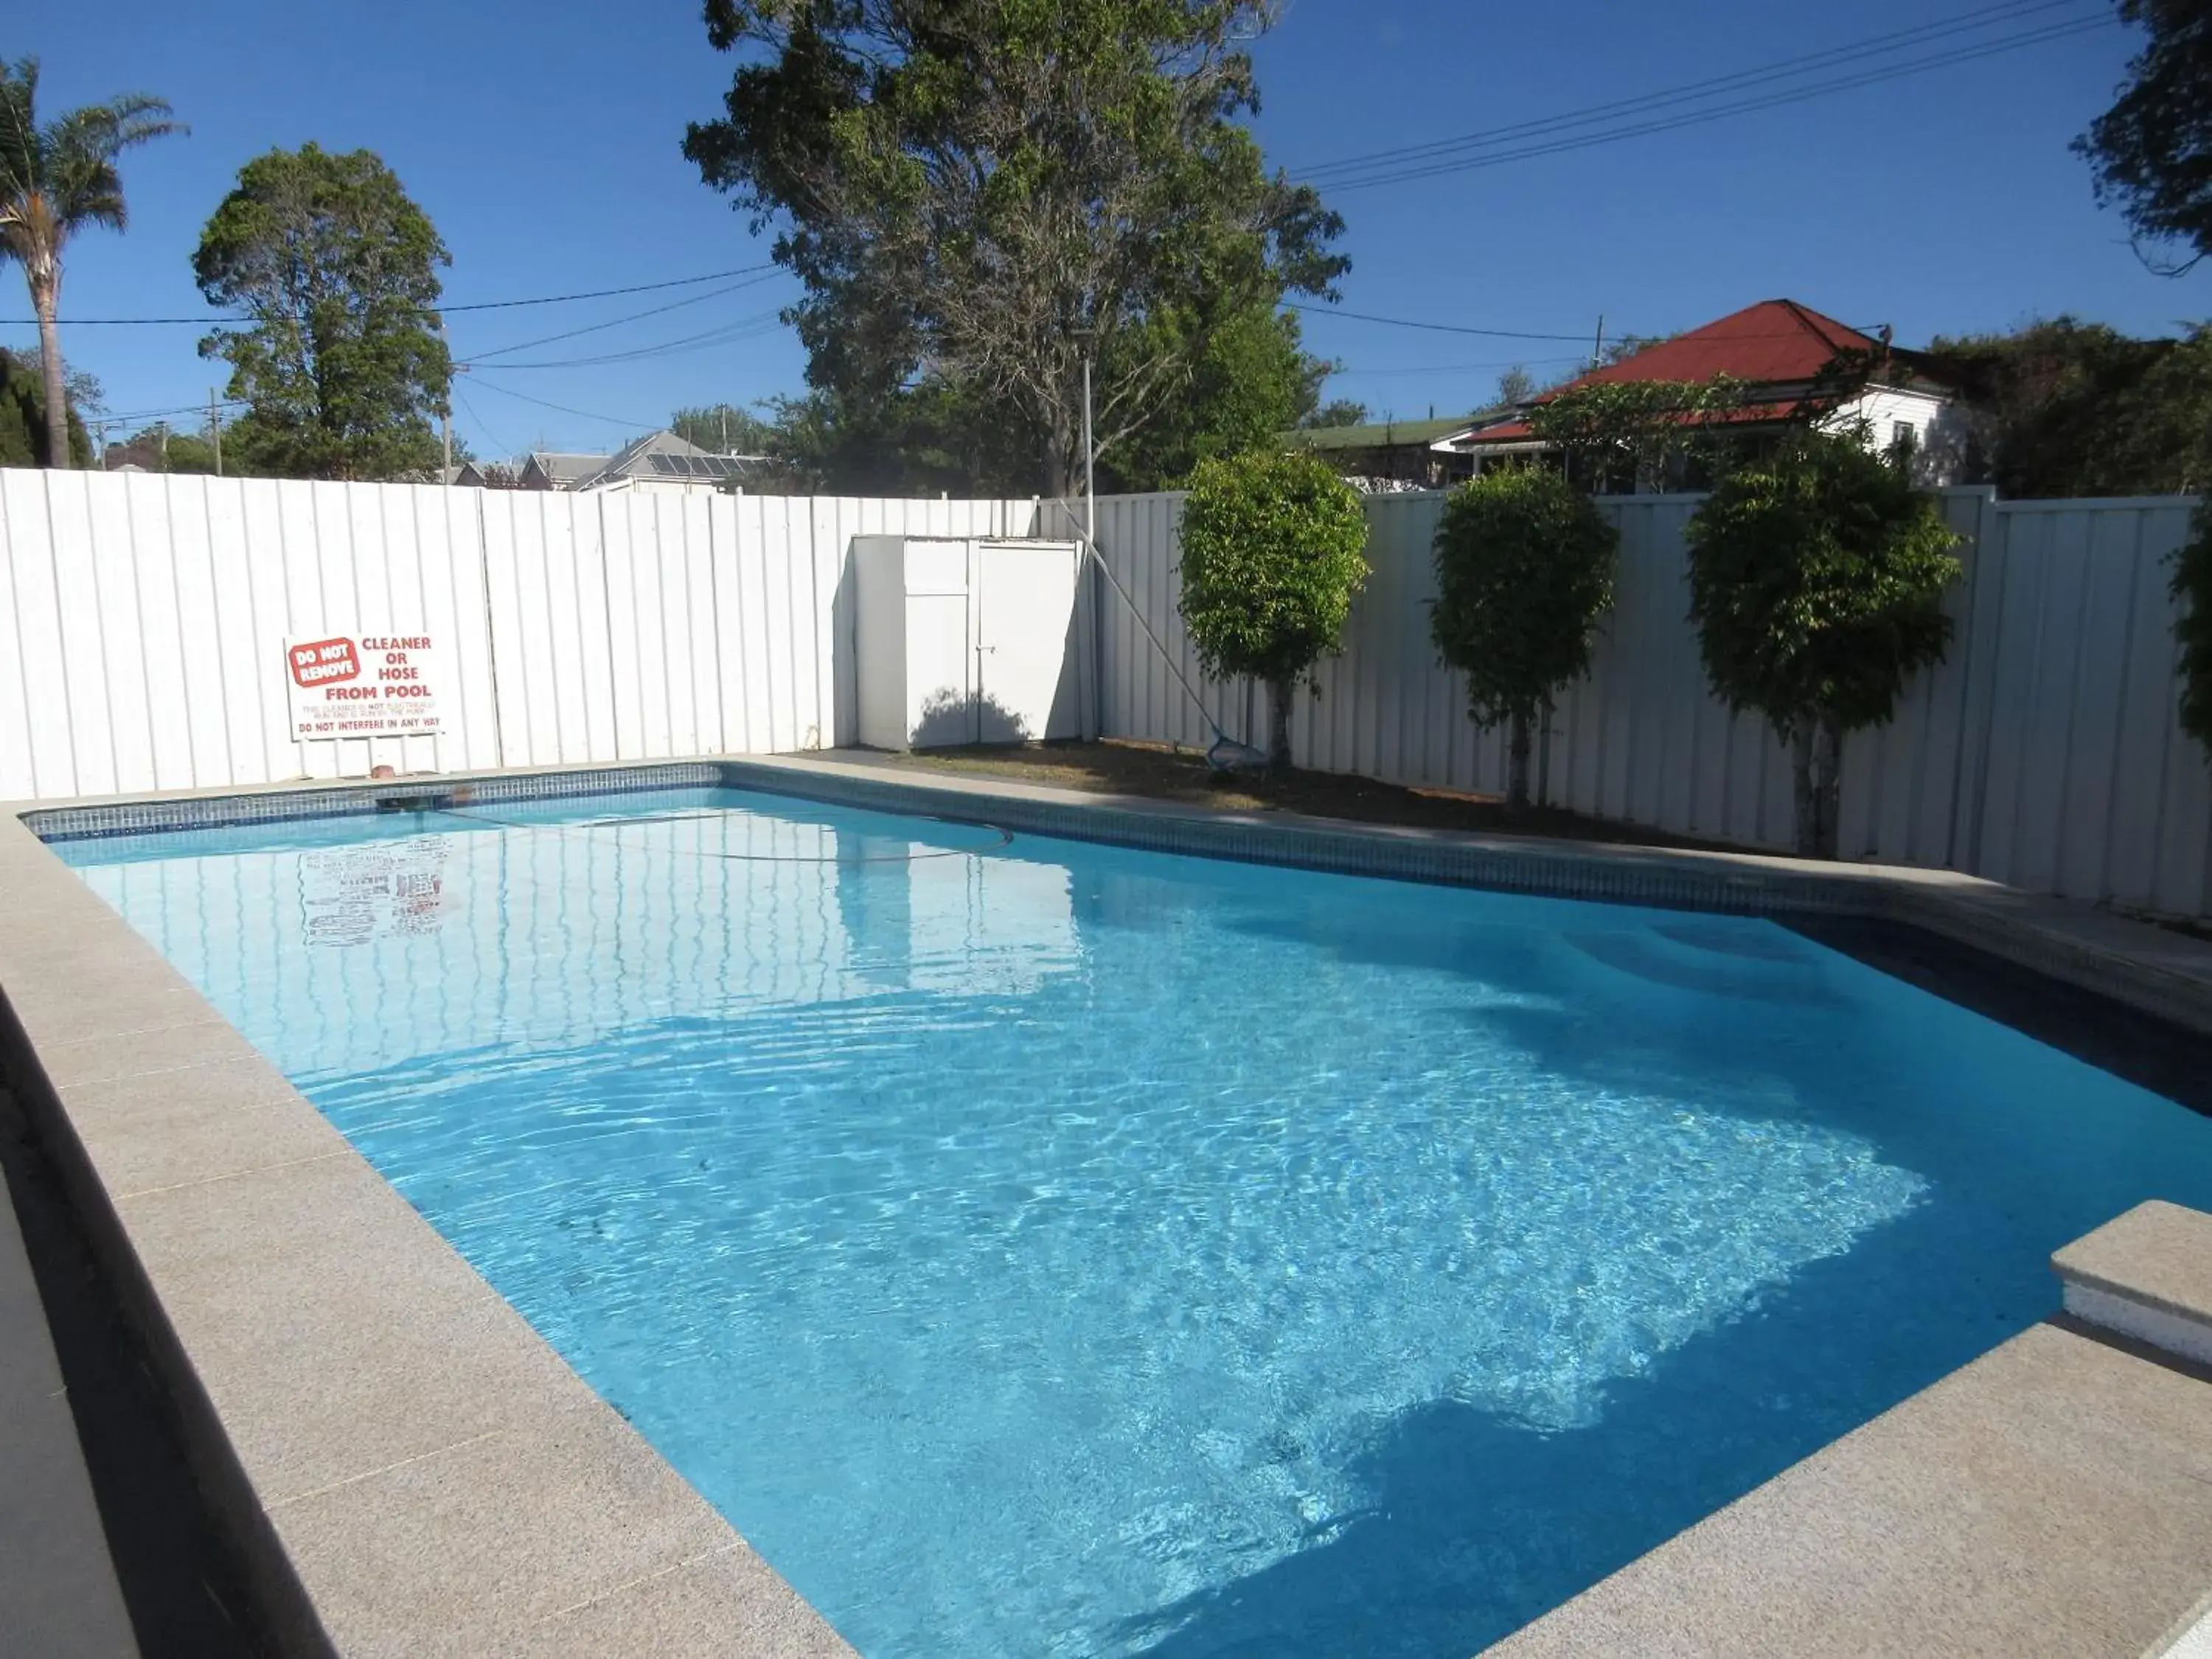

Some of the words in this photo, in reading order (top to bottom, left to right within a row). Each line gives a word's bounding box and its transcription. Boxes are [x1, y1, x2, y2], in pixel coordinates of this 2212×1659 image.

[362, 637, 431, 650] CLEANER
[296, 652, 316, 665] DO
[321, 644, 348, 659] NOT
[386, 653, 407, 664] OR
[300, 661, 354, 679] REMOVE
[379, 667, 419, 680] HOSE
[326, 687, 377, 700] FROM
[385, 685, 431, 698] POOL
[299, 723, 311, 733] DO
[316, 723, 334, 731] NOT
[338, 720, 383, 730] INTERFERE
[400, 718, 420, 727] ANY
[423, 717, 440, 726] WAY
